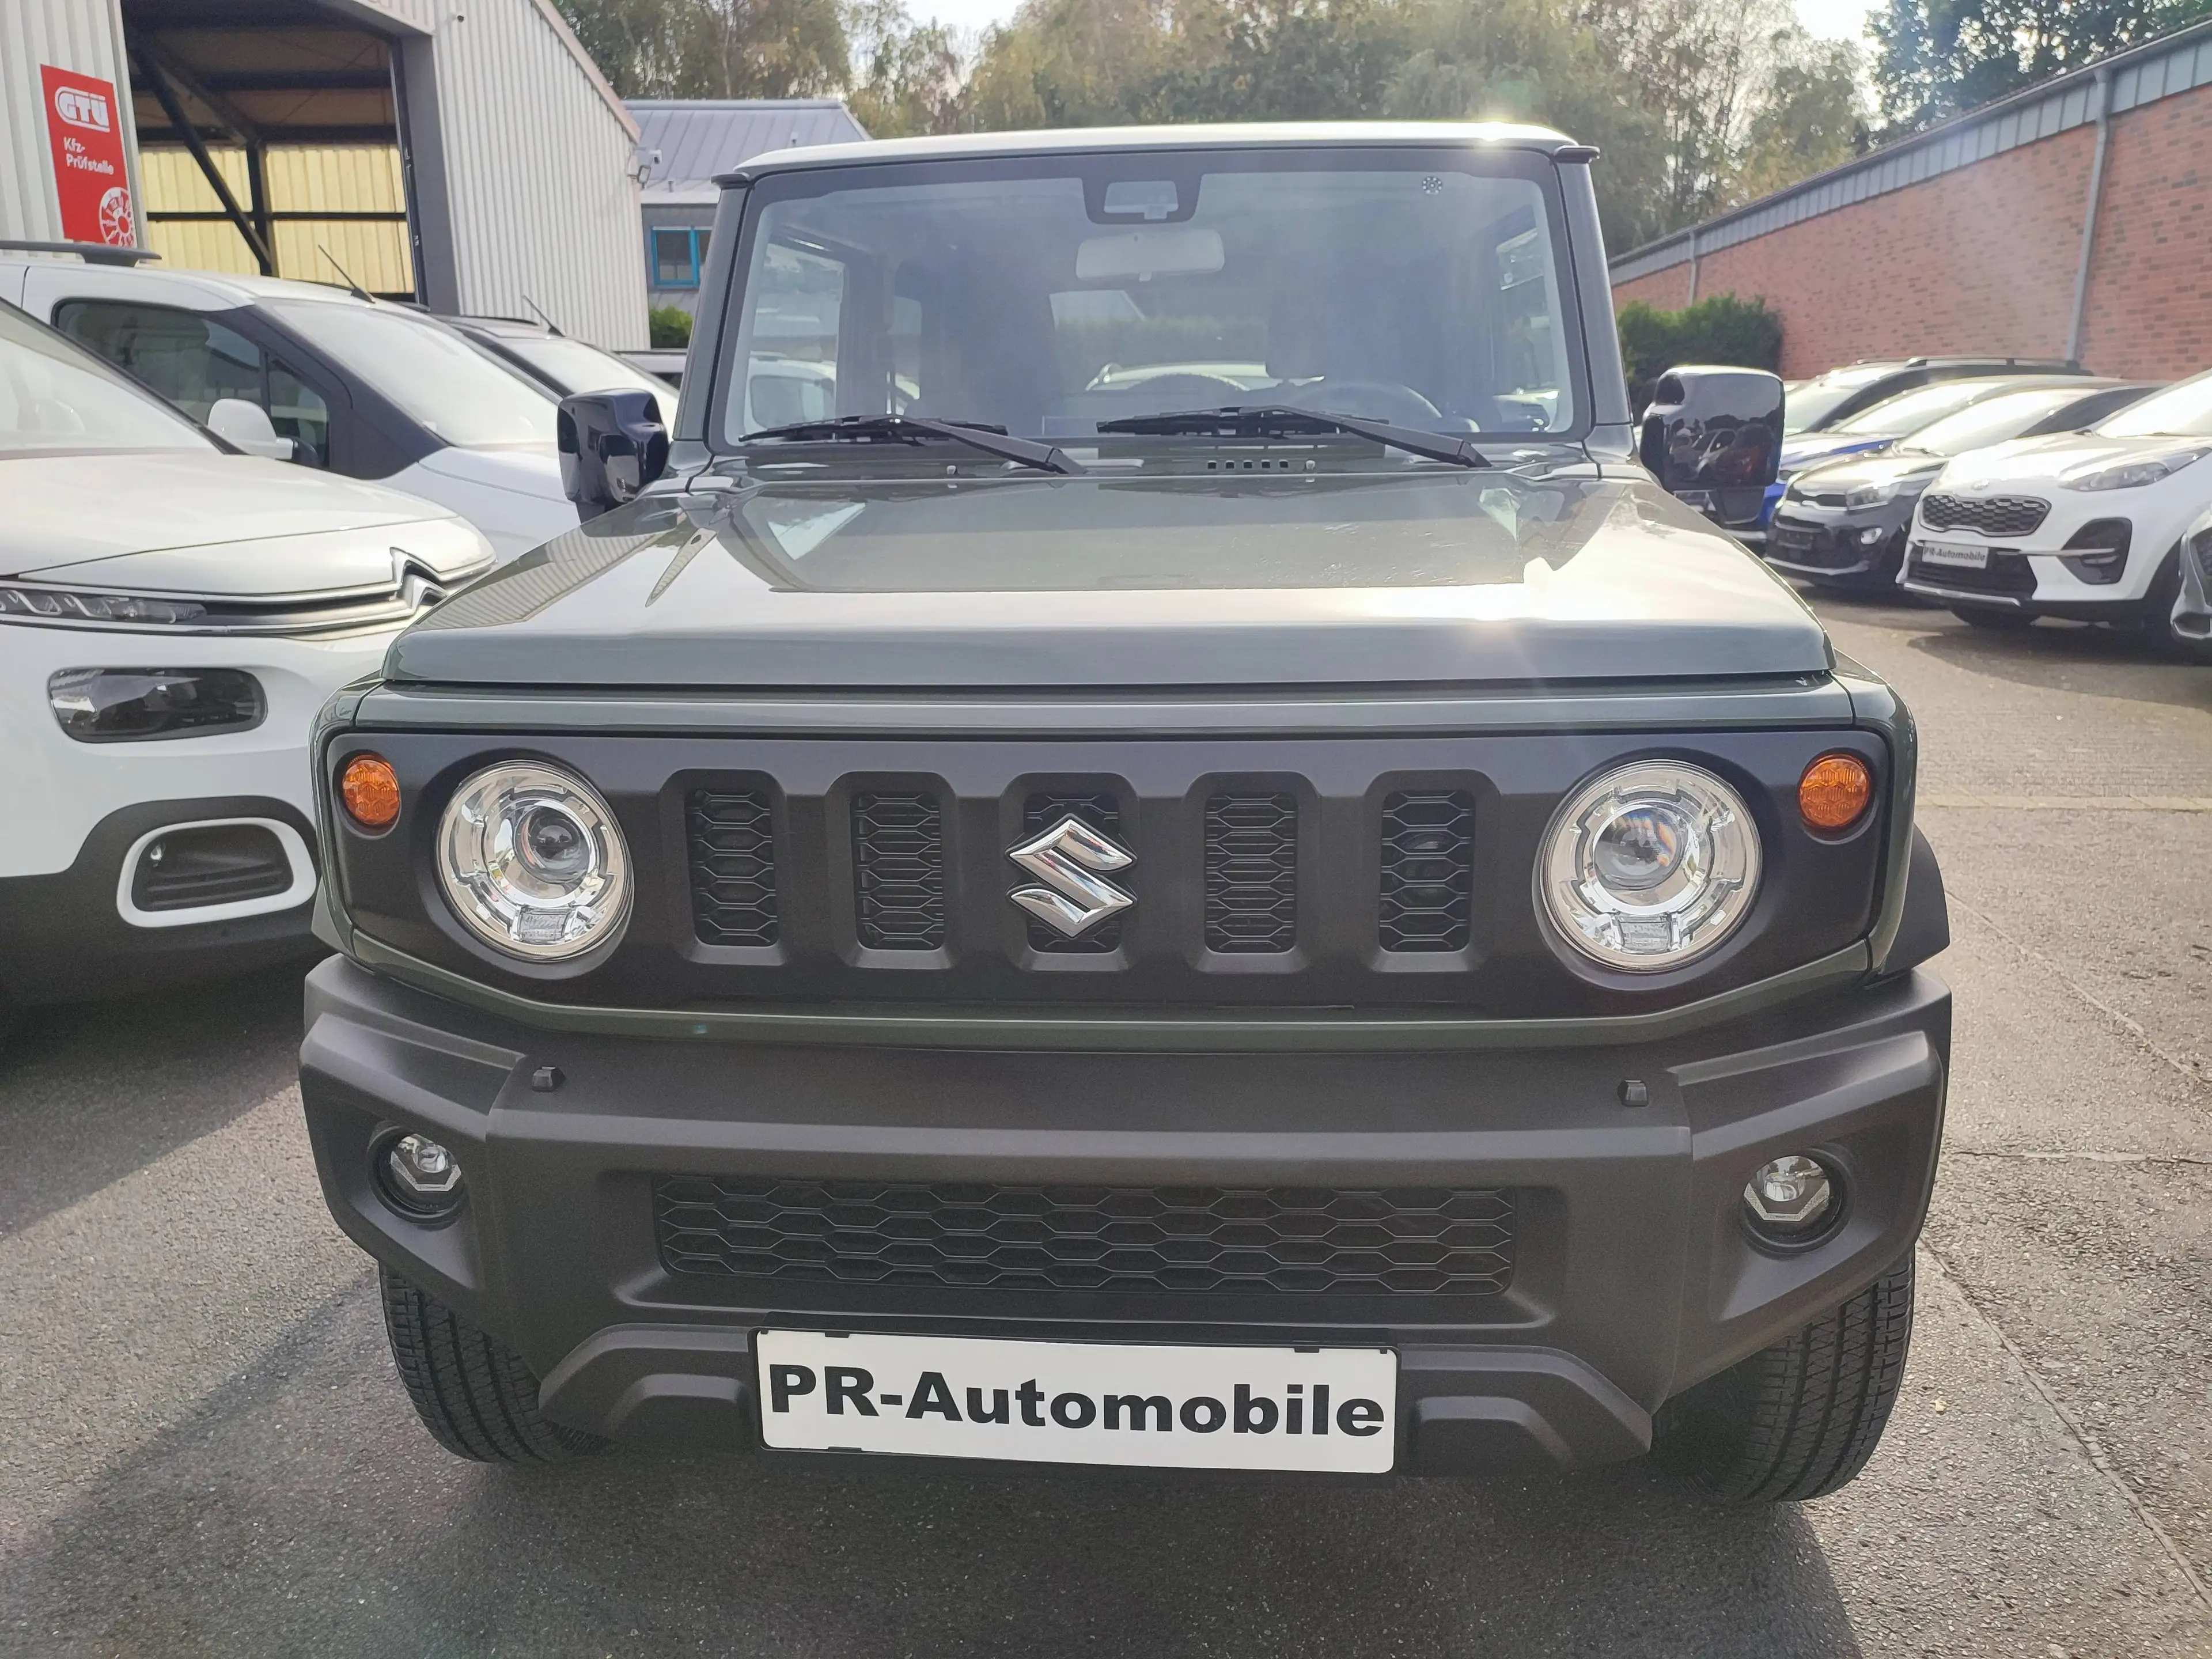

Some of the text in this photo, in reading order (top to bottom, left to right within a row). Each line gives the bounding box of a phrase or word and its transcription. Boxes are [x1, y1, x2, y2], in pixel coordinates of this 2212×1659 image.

[66, 153, 114, 175] Prüfstelle
[1923, 547, 1986, 562] PR-Automobile
[769, 1363, 1385, 1437] PR-Automobile
